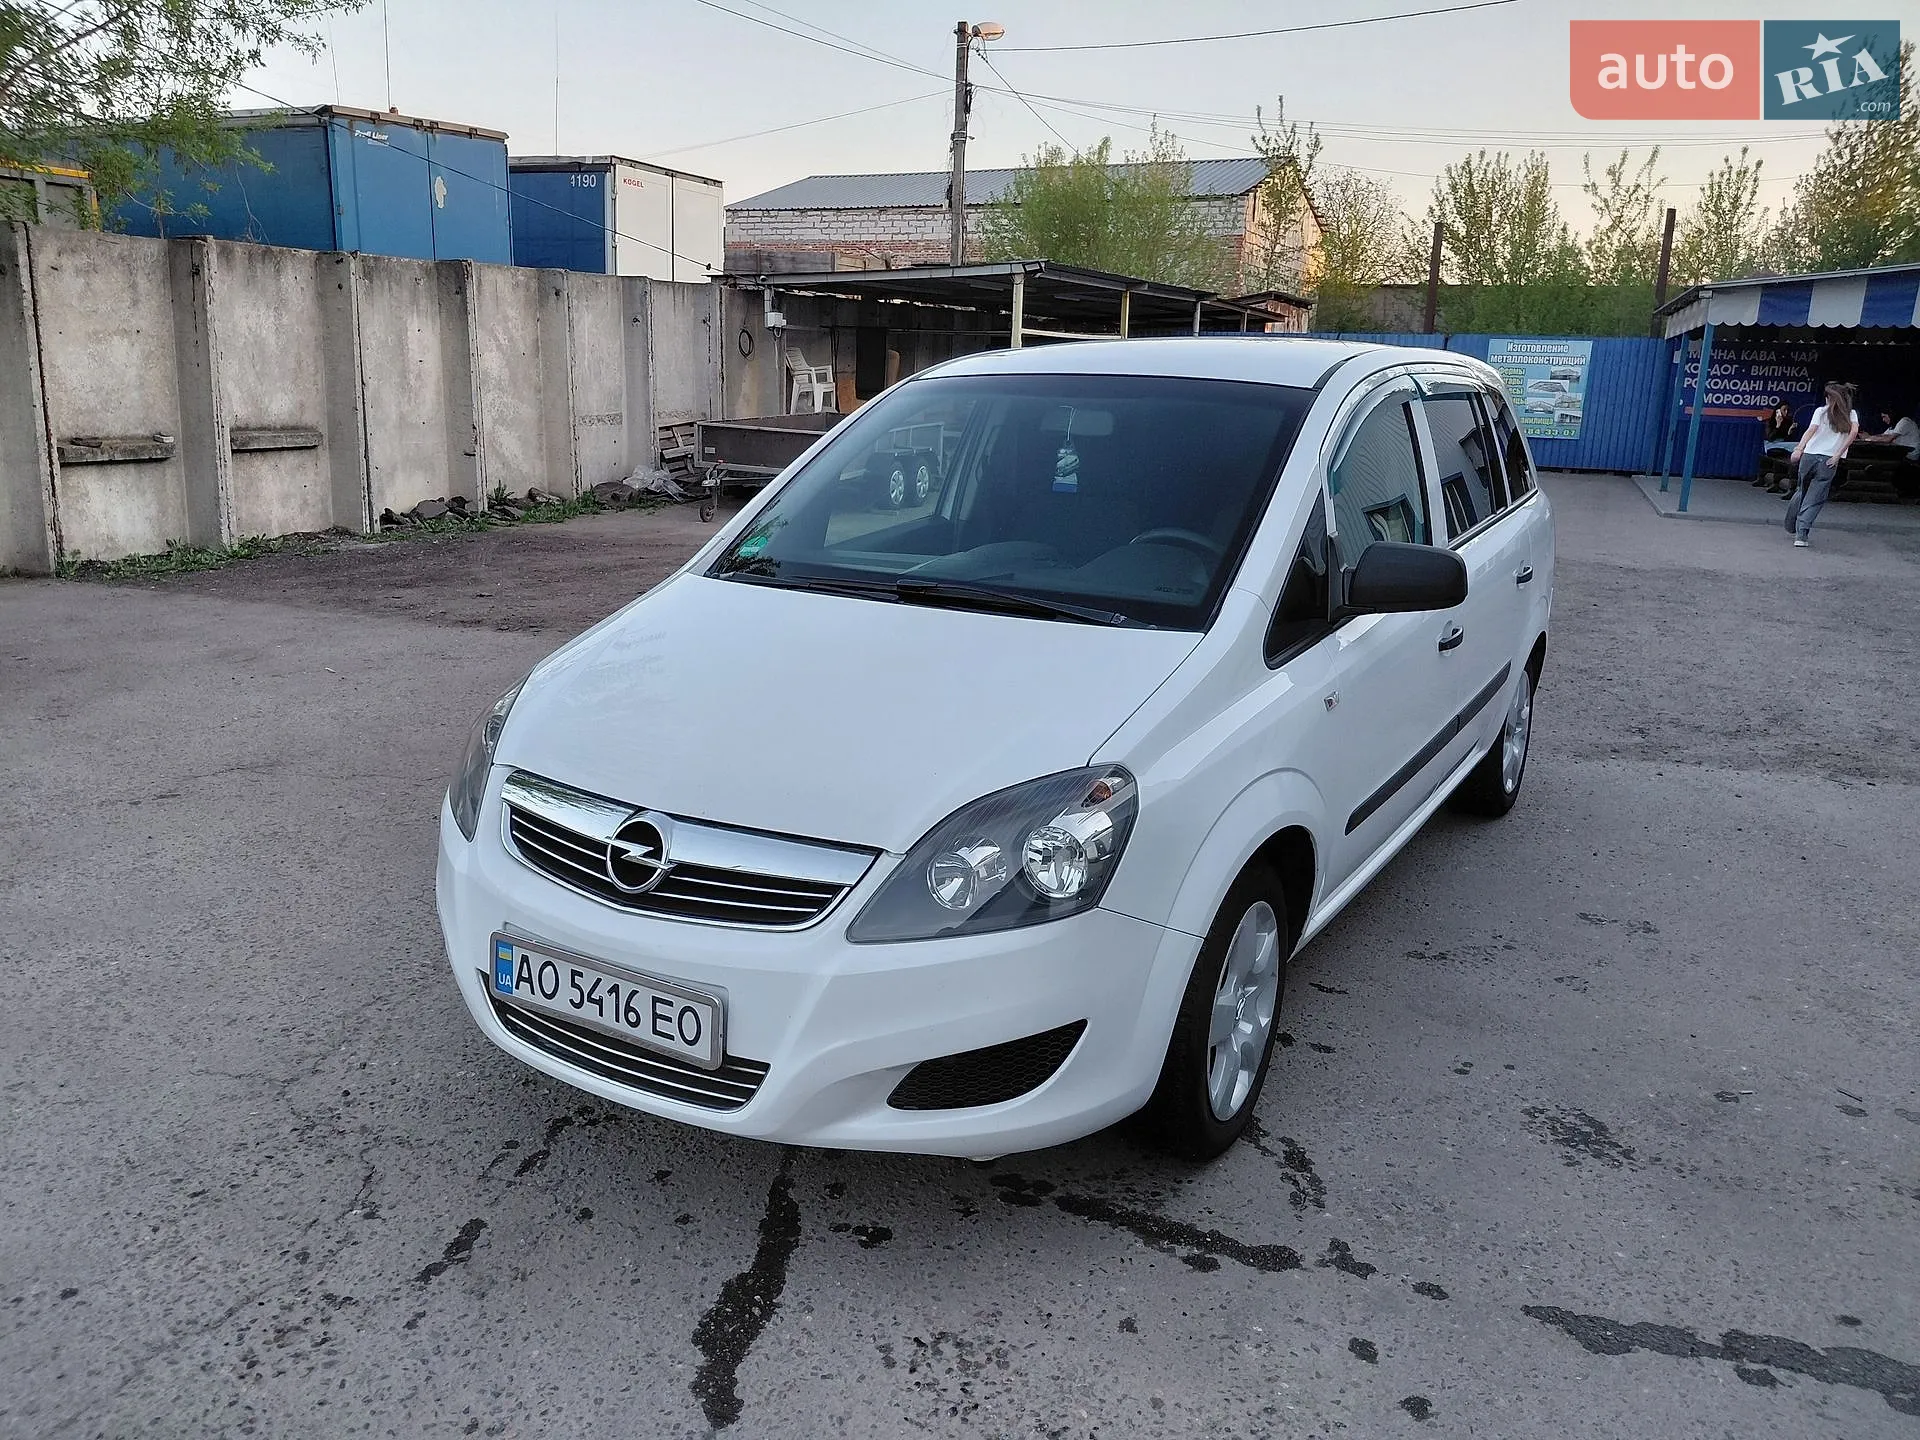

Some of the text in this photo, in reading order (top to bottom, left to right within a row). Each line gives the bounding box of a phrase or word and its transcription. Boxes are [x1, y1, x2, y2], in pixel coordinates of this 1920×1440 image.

[1507, 342, 1569, 353] Изготовление
[1490, 354, 1586, 365] металлоконструкций
[1741, 350, 1777, 361] КАВА
[1750, 365, 1809, 377] ВИПІЧКА
[1767, 378, 1815, 393] НАПОЇ
[498, 953, 702, 1047] UA AO 5416 EO
